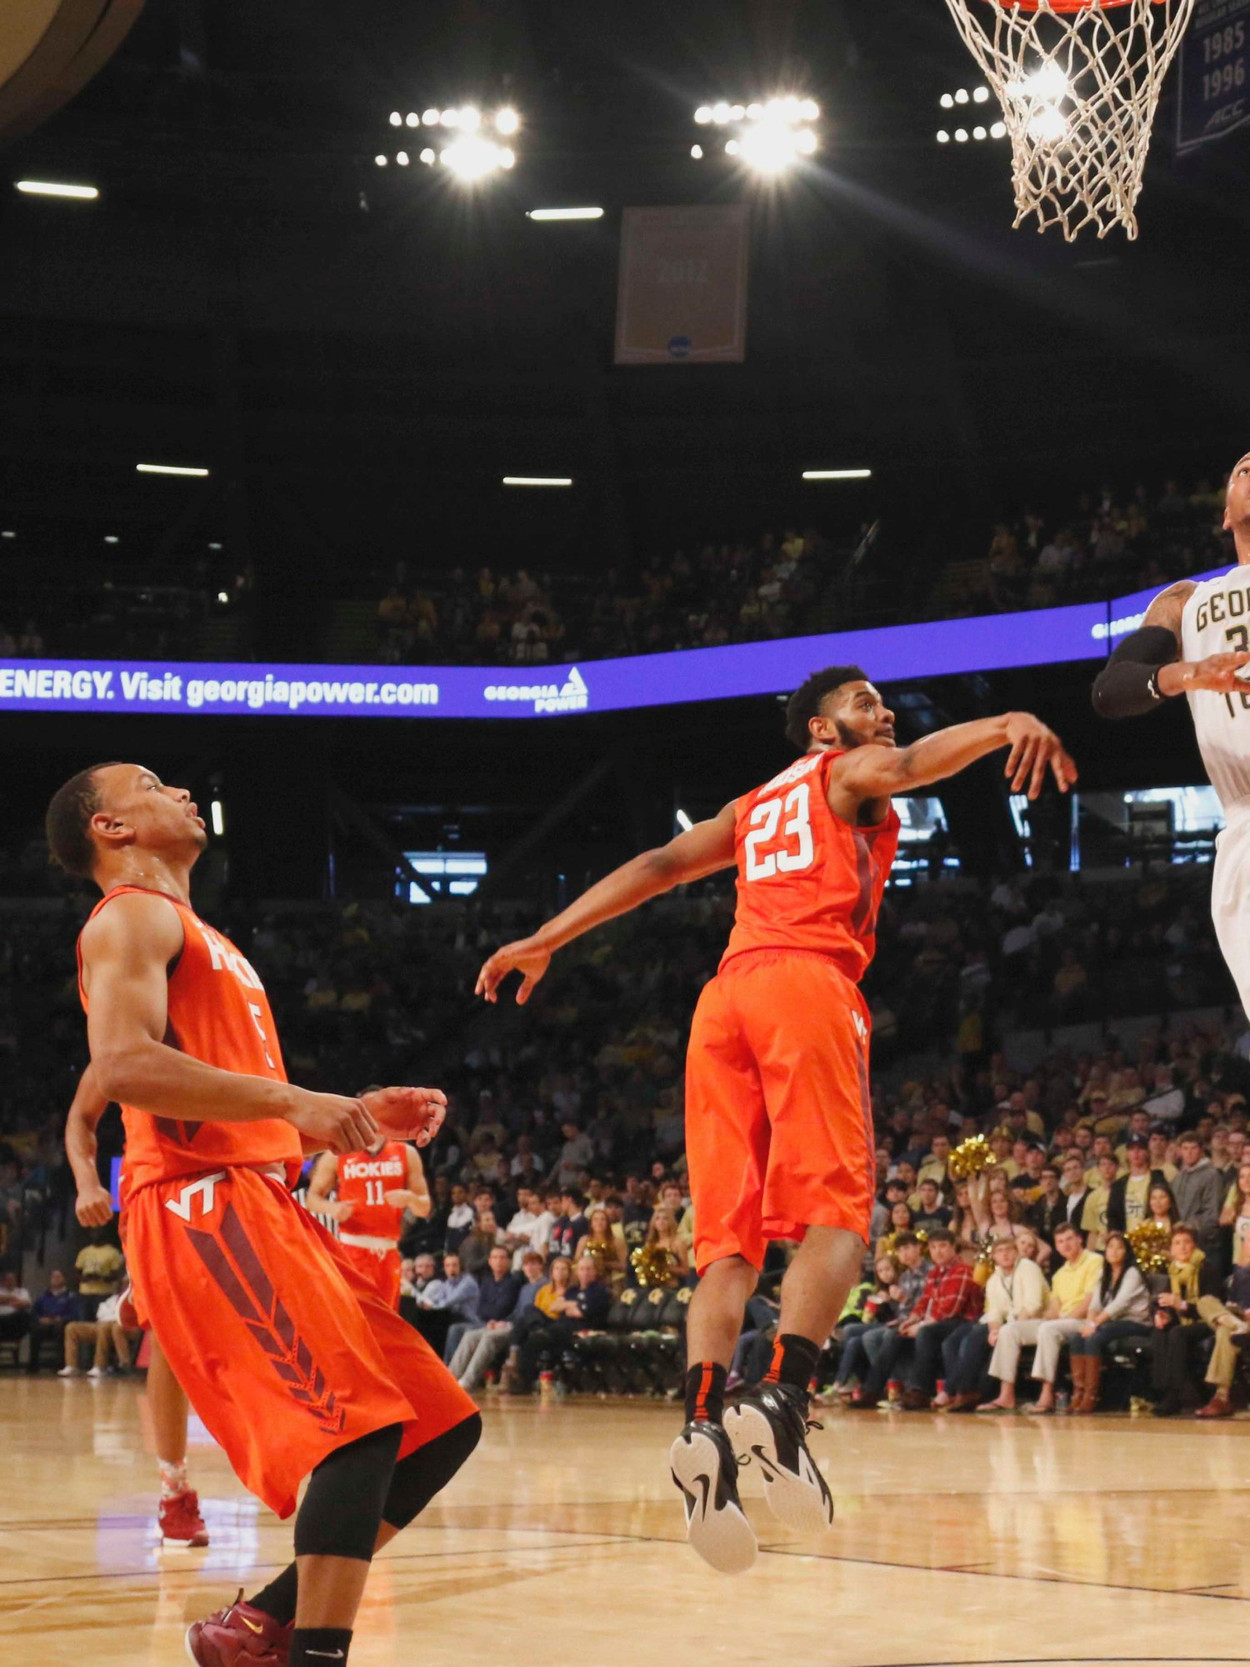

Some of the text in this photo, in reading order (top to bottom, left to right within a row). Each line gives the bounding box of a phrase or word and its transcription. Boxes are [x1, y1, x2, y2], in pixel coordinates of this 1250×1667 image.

[1203, 20, 1245, 63] 1985
[1203, 57, 1245, 101] 1996
[0, 669, 439, 709] ENERGY. Visit georgiapower.com
[483, 684, 558, 701] GEORGIA
[534, 695, 588, 713] POWER
[745, 782, 814, 882] 23
[343, 1161, 404, 1180] HOKIES
[164, 1170, 227, 1222] VT
[365, 1180, 385, 1206] 11
